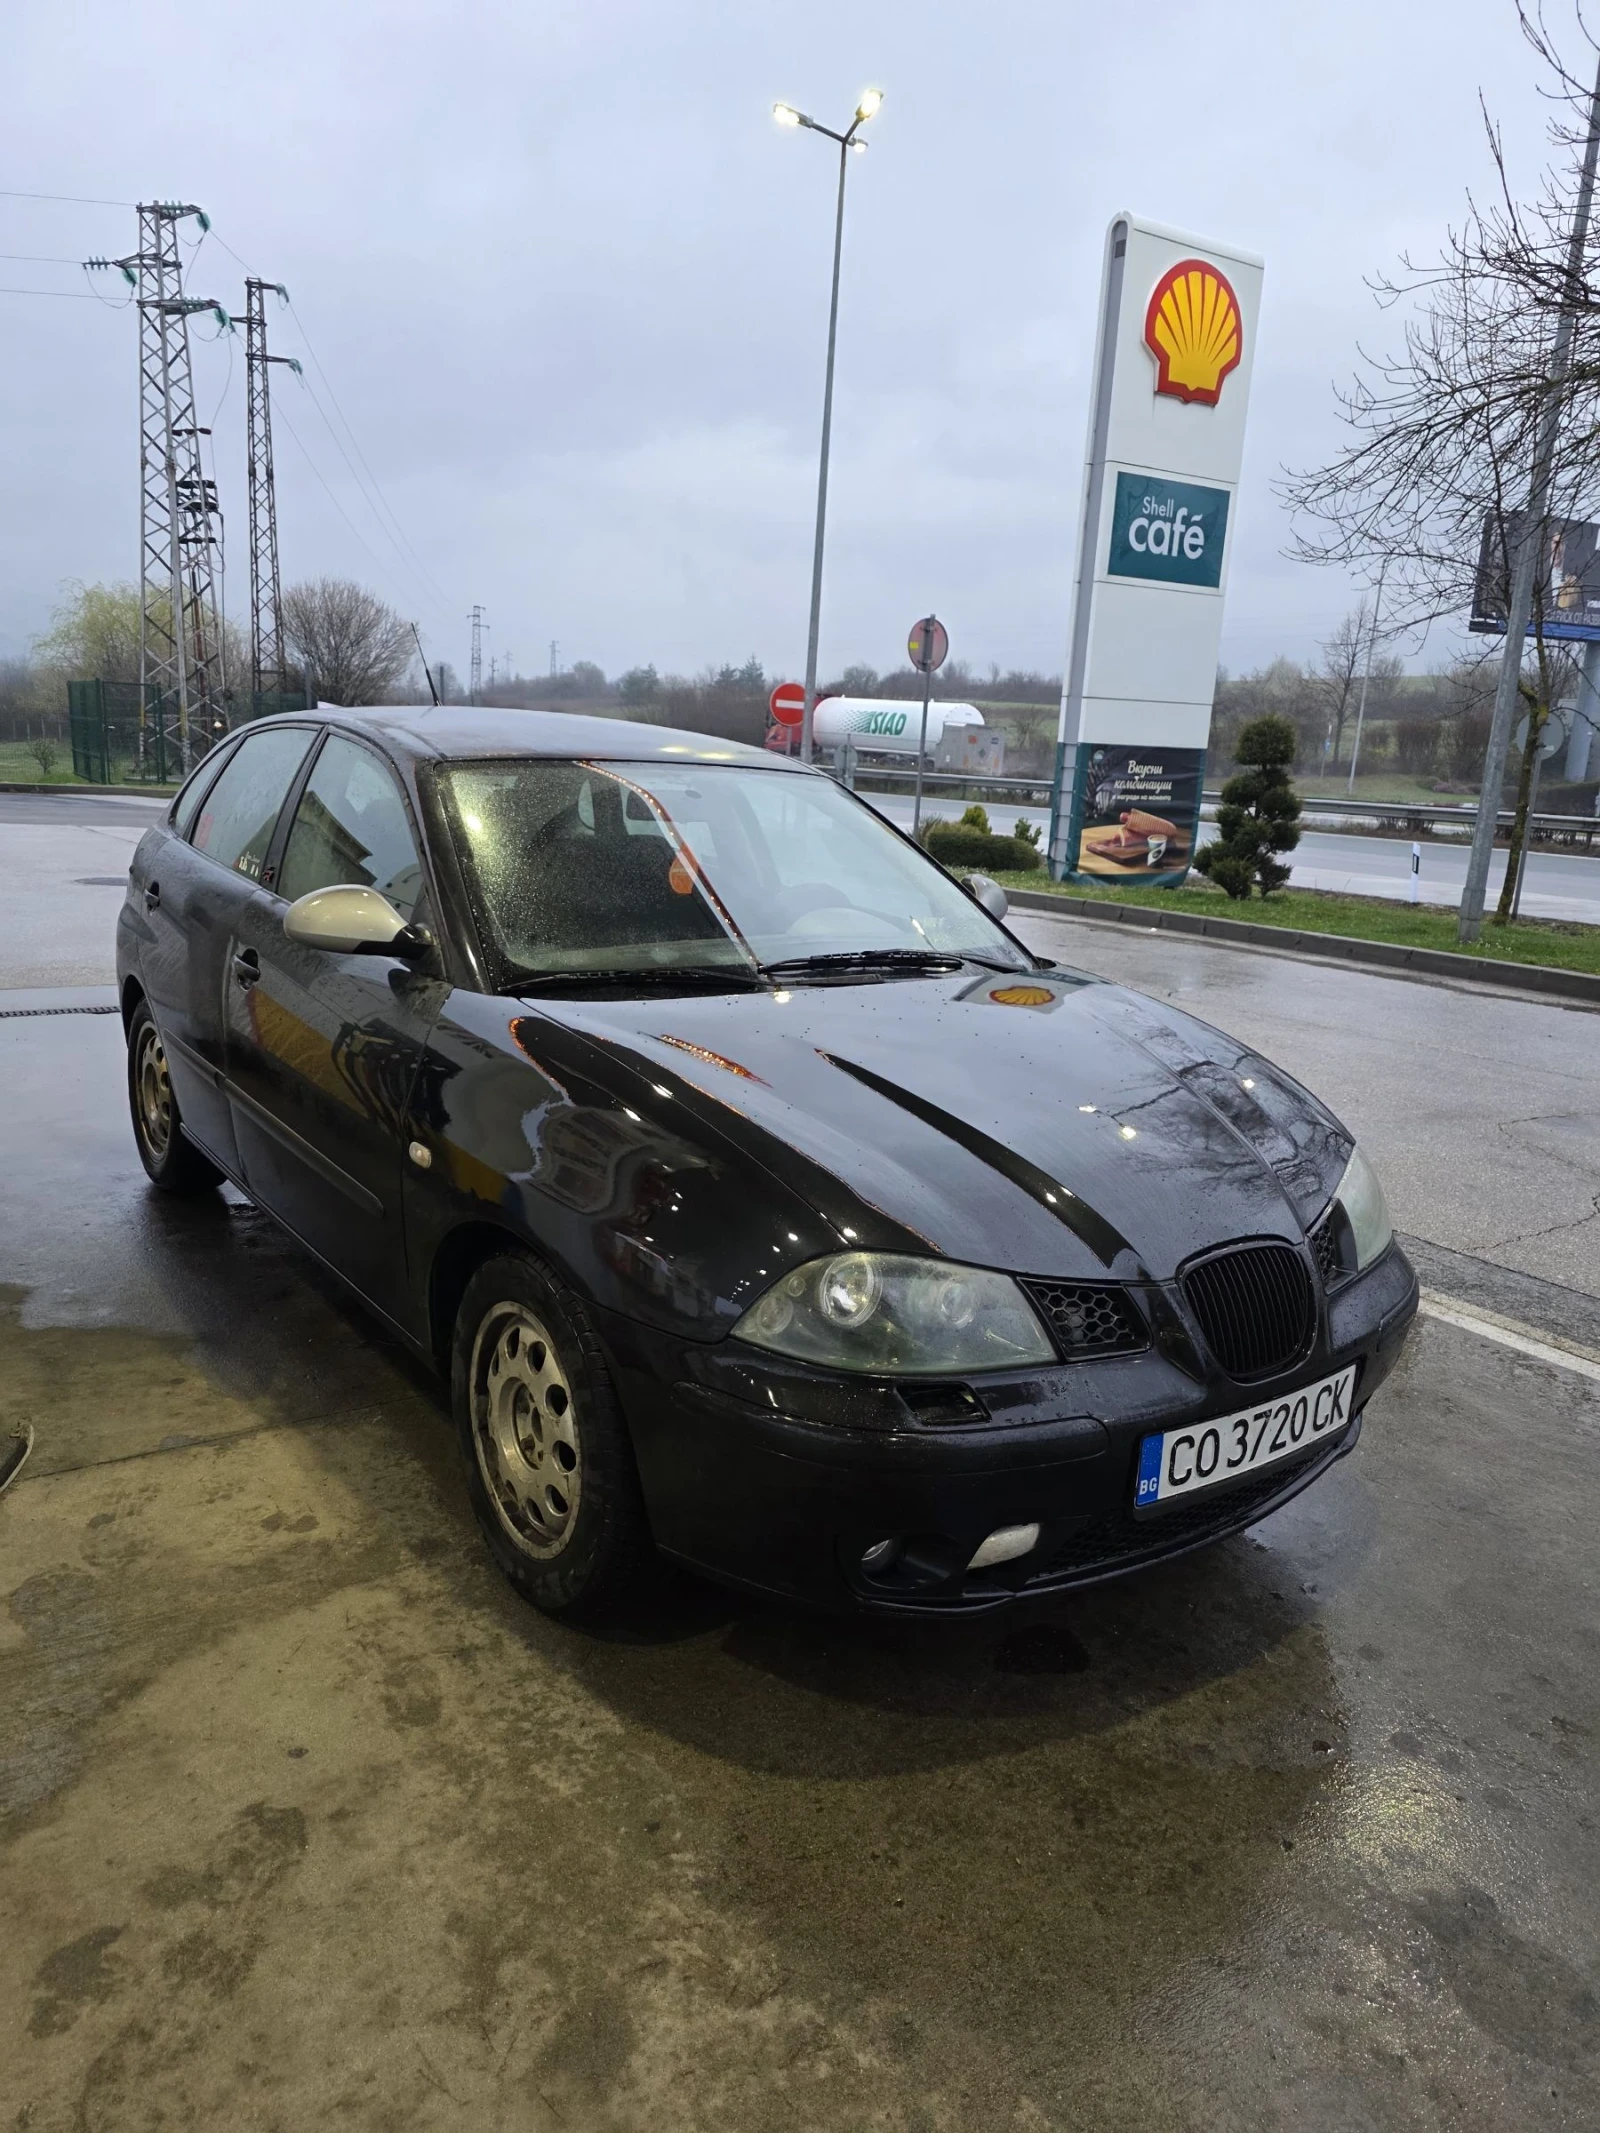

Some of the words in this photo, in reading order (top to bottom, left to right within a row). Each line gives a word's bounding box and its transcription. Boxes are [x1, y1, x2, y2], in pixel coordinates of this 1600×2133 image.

[1142, 495, 1174, 519] Shell
[1128, 506, 1205, 560] café
[870, 711, 908, 736] SIAD
[1127, 759, 1163, 778] Вкусни
[1114, 776, 1172, 794] комбинации
[1168, 1428, 1220, 1486] CO
[1227, 1395, 1308, 1468] 3720
[1312, 1374, 1349, 1432] CK
[1139, 1476, 1158, 1495] BG
